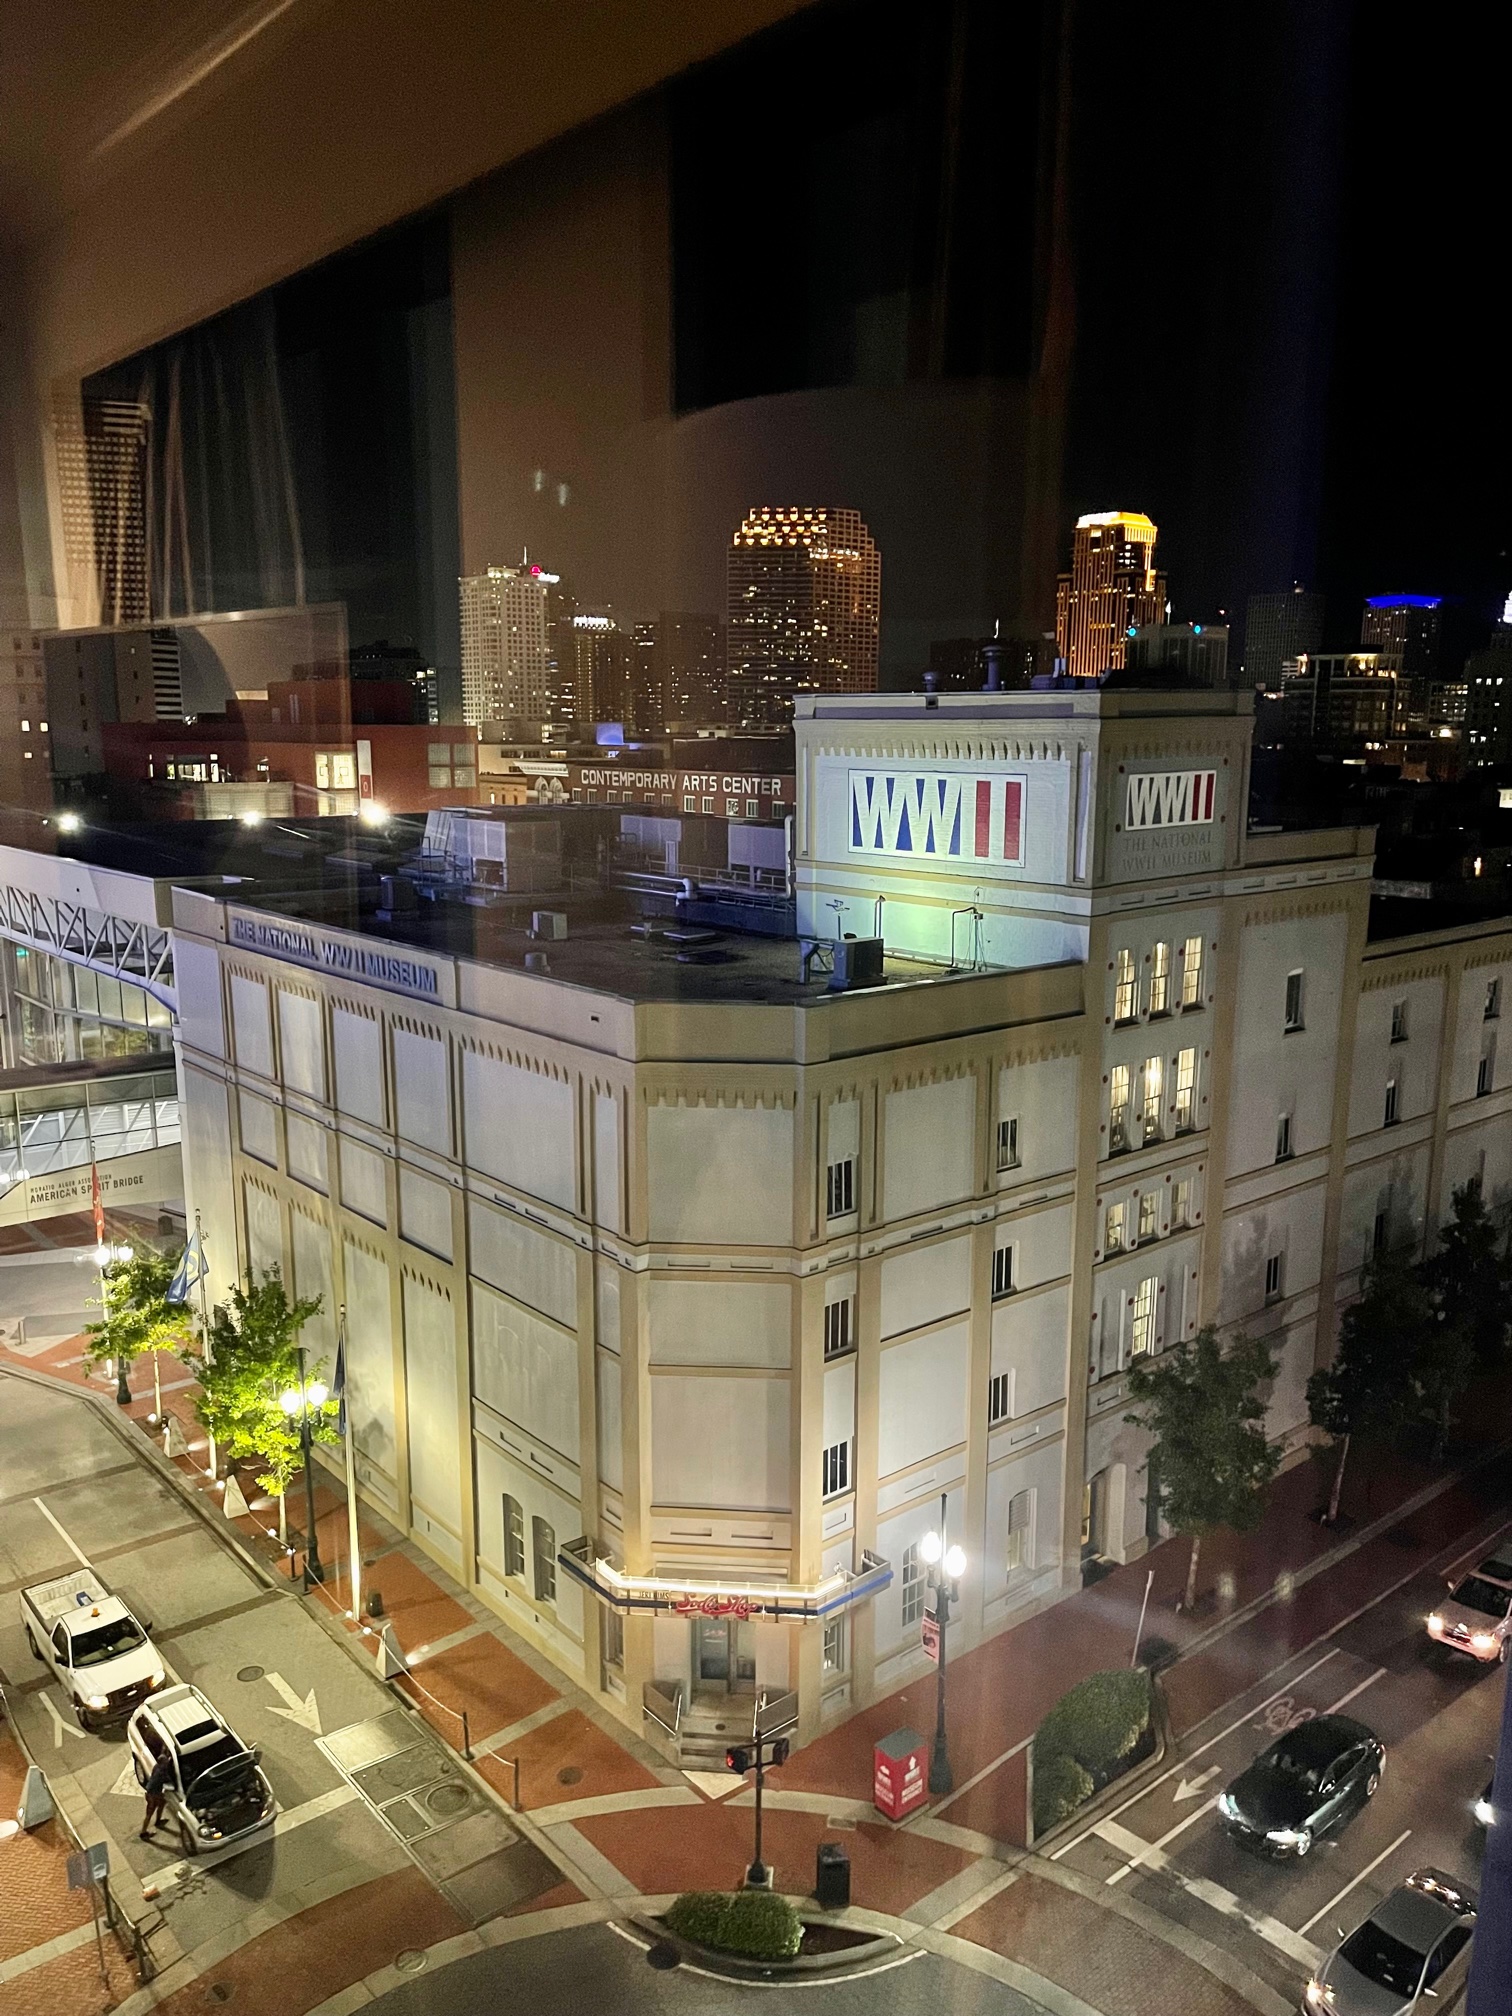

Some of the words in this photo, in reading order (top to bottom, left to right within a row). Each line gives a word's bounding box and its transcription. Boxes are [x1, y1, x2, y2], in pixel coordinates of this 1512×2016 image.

[581, 769, 677, 790] CONTEMPORARY
[682, 774, 718, 793] ARTS
[722, 776, 782, 796] CENTER
[1127, 773, 1215, 827] WWII
[852, 776, 1021, 860] WWII
[1124, 837, 1146, 852] THE
[1152, 830, 1212, 848] NATIONAL
[1122, 856, 1156, 872] WWII
[1161, 850, 1212, 868] MUSEUM
[233, 916, 255, 943] THE
[257, 923, 319, 961] NATIONAL
[365, 953, 438, 994] MUSEUM
[30, 1184, 55, 1194] HORATIO
[58, 1180, 75, 1189] ALGER
[78, 1173, 112, 1185] ASSOTION
[30, 1186, 78, 1204] AMERICAN
[81, 1180, 110, 1195] SPRIT
[113, 1174, 144, 1189] BRIDGE
[718, 1594, 758, 1619] Shop
